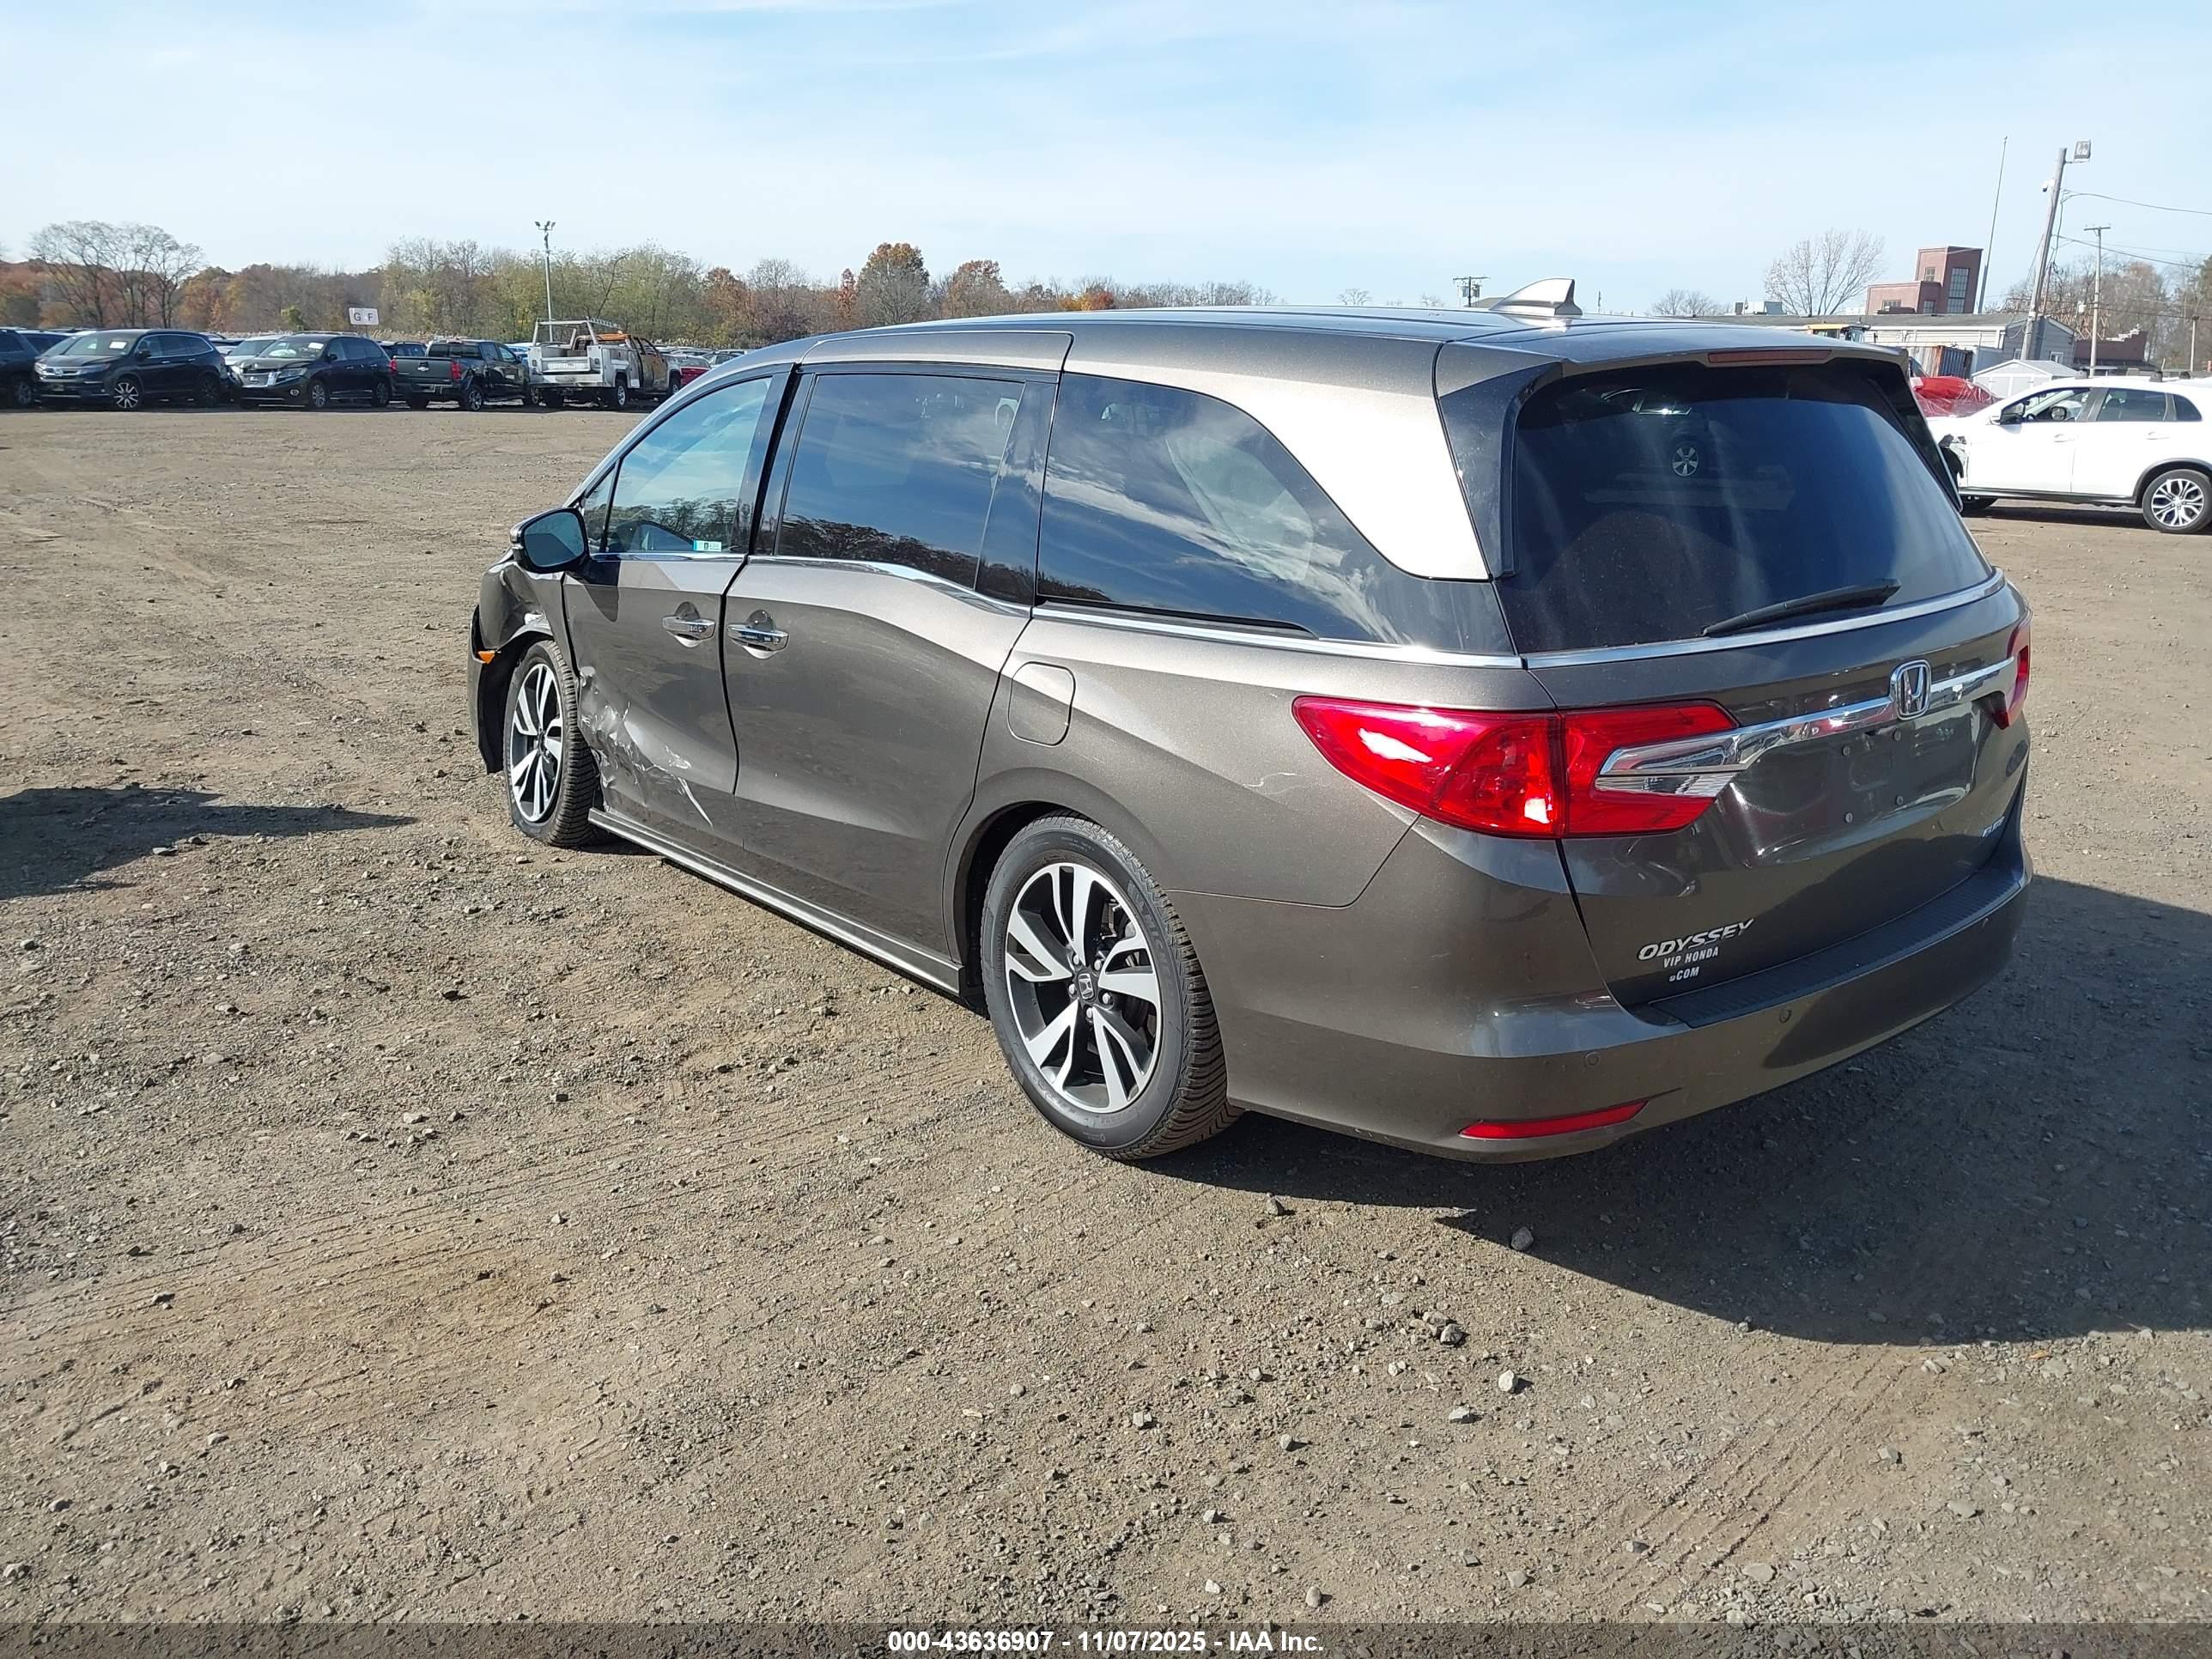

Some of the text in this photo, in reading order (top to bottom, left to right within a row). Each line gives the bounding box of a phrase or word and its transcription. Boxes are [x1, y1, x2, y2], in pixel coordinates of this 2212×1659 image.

[353, 312, 374, 322] G F
[1638, 918, 1754, 961] ODYSSEY
[1663, 947, 1719, 969] VIP HONDA
